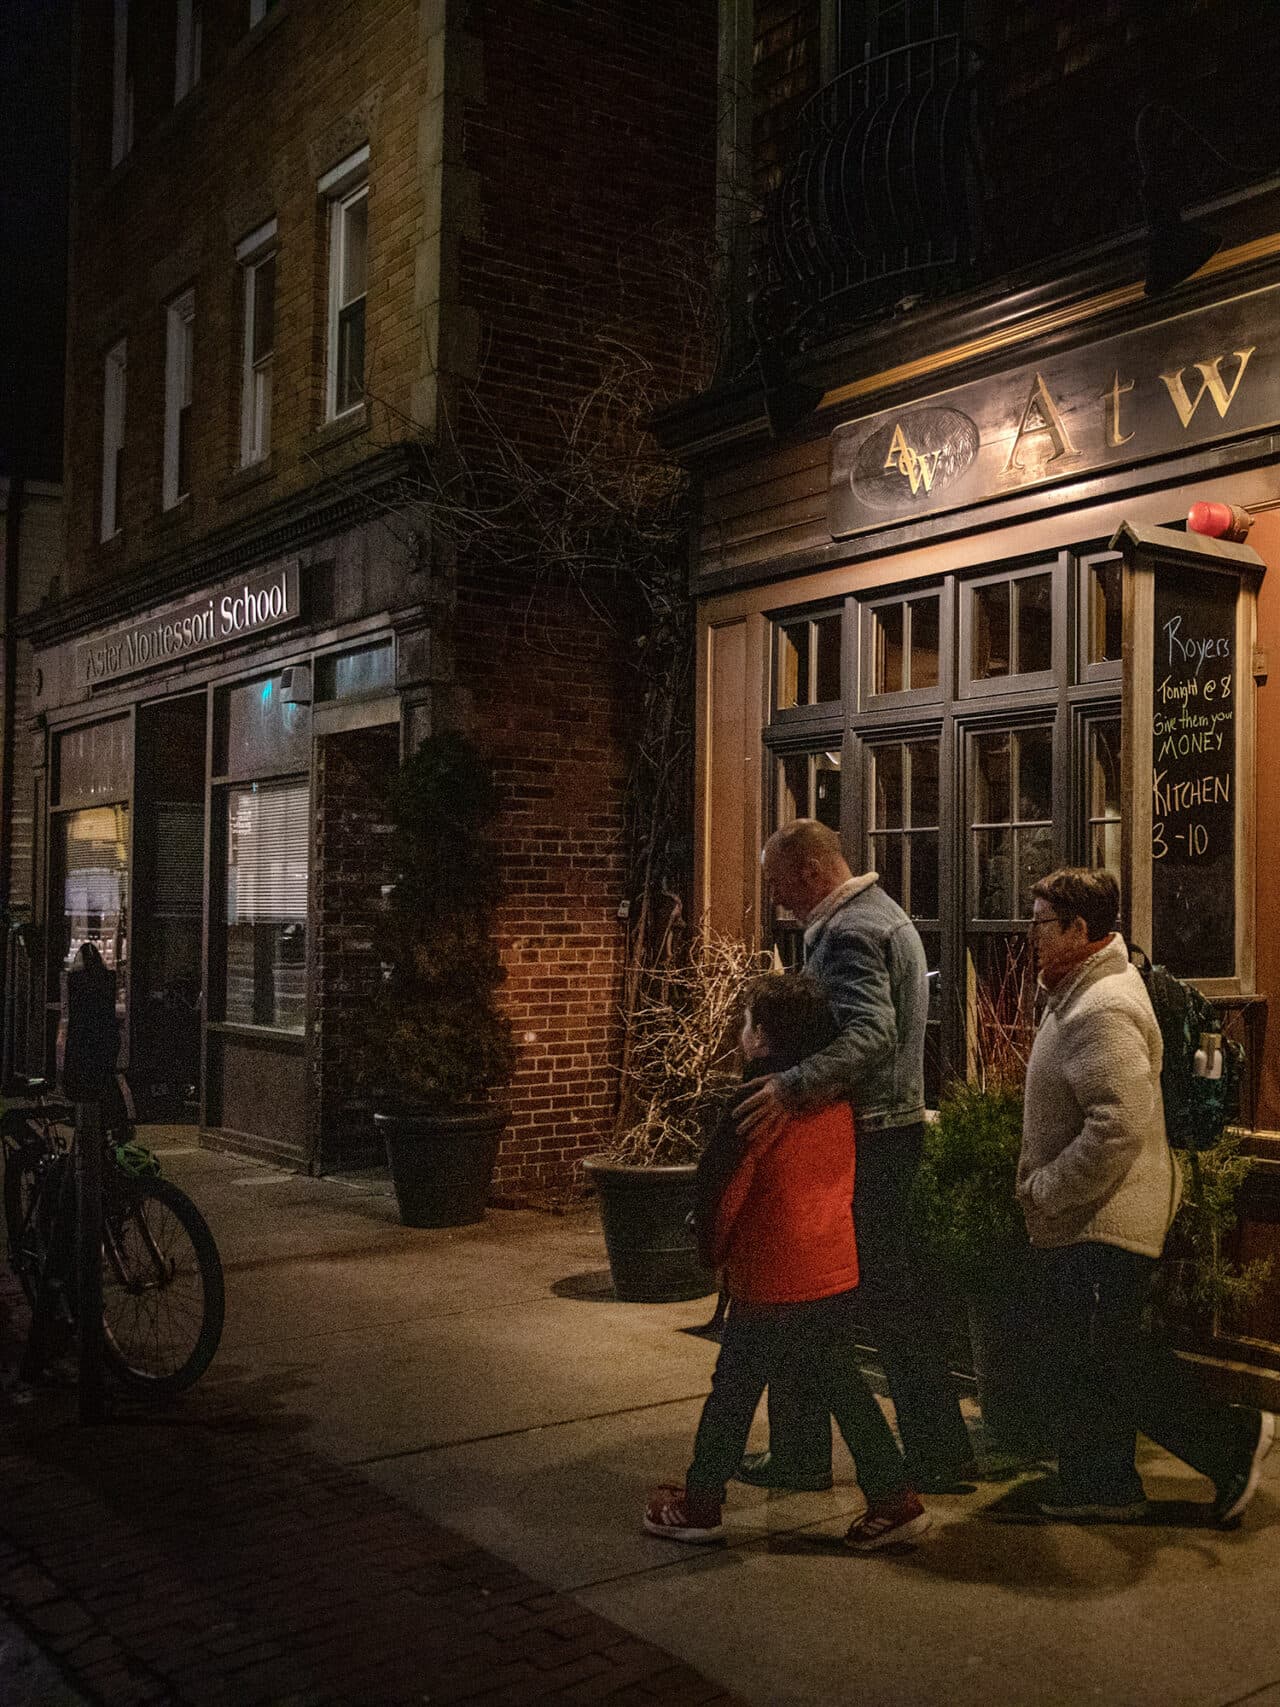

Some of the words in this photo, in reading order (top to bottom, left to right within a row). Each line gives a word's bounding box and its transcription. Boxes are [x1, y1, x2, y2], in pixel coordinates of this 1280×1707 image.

[127, 600, 216, 667] Montessori
[220, 571, 289, 634] School
[1157, 674, 1198, 708] Tonight
[1203, 679, 1217, 701] @
[1220, 674, 1231, 698] 8
[1152, 712, 1177, 736] Give
[1178, 708, 1208, 729] them
[1210, 711, 1233, 735] your
[1157, 731, 1223, 762] MONEY
[1152, 767, 1230, 817] KITCHEN
